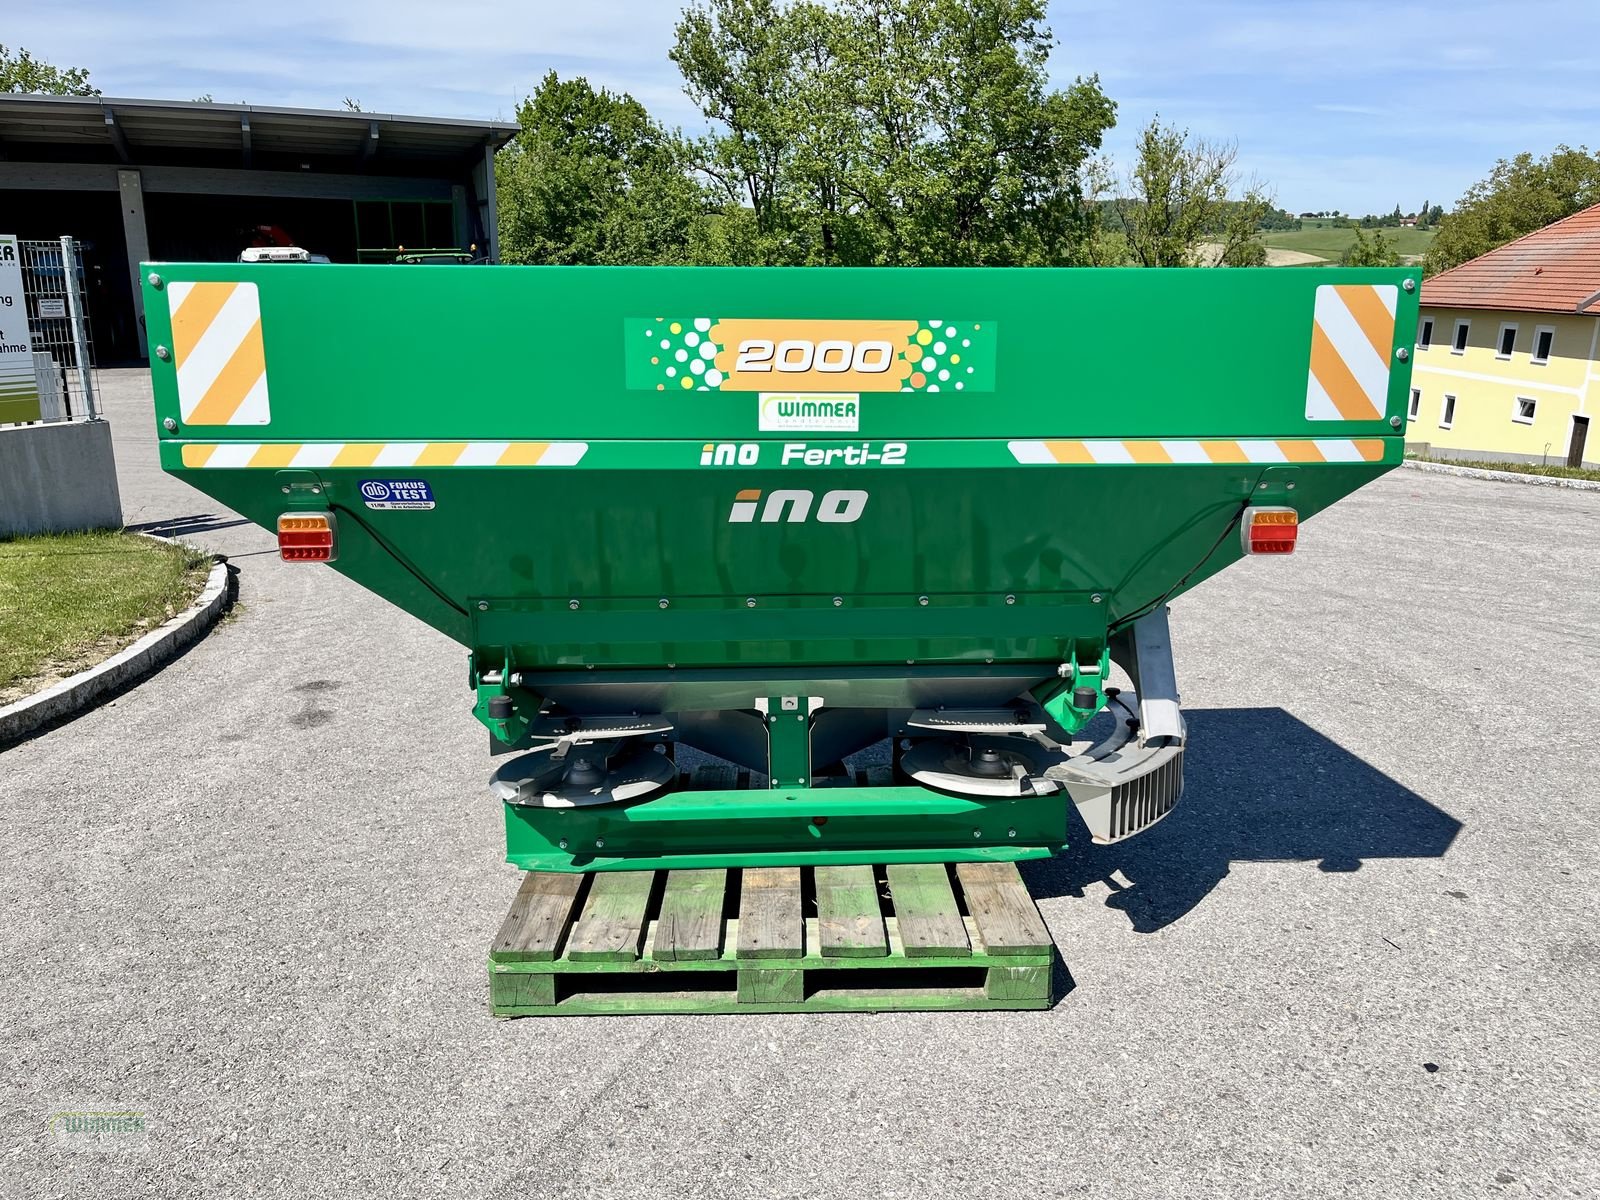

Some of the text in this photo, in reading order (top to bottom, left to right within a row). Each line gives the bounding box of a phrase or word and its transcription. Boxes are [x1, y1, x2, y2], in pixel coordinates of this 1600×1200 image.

[736, 339, 894, 374] 2000
[777, 401, 856, 418] WIMMER
[781, 443, 908, 466] Ferti-2
[366, 483, 386, 496] DLG
[392, 490, 427, 500] TEST
